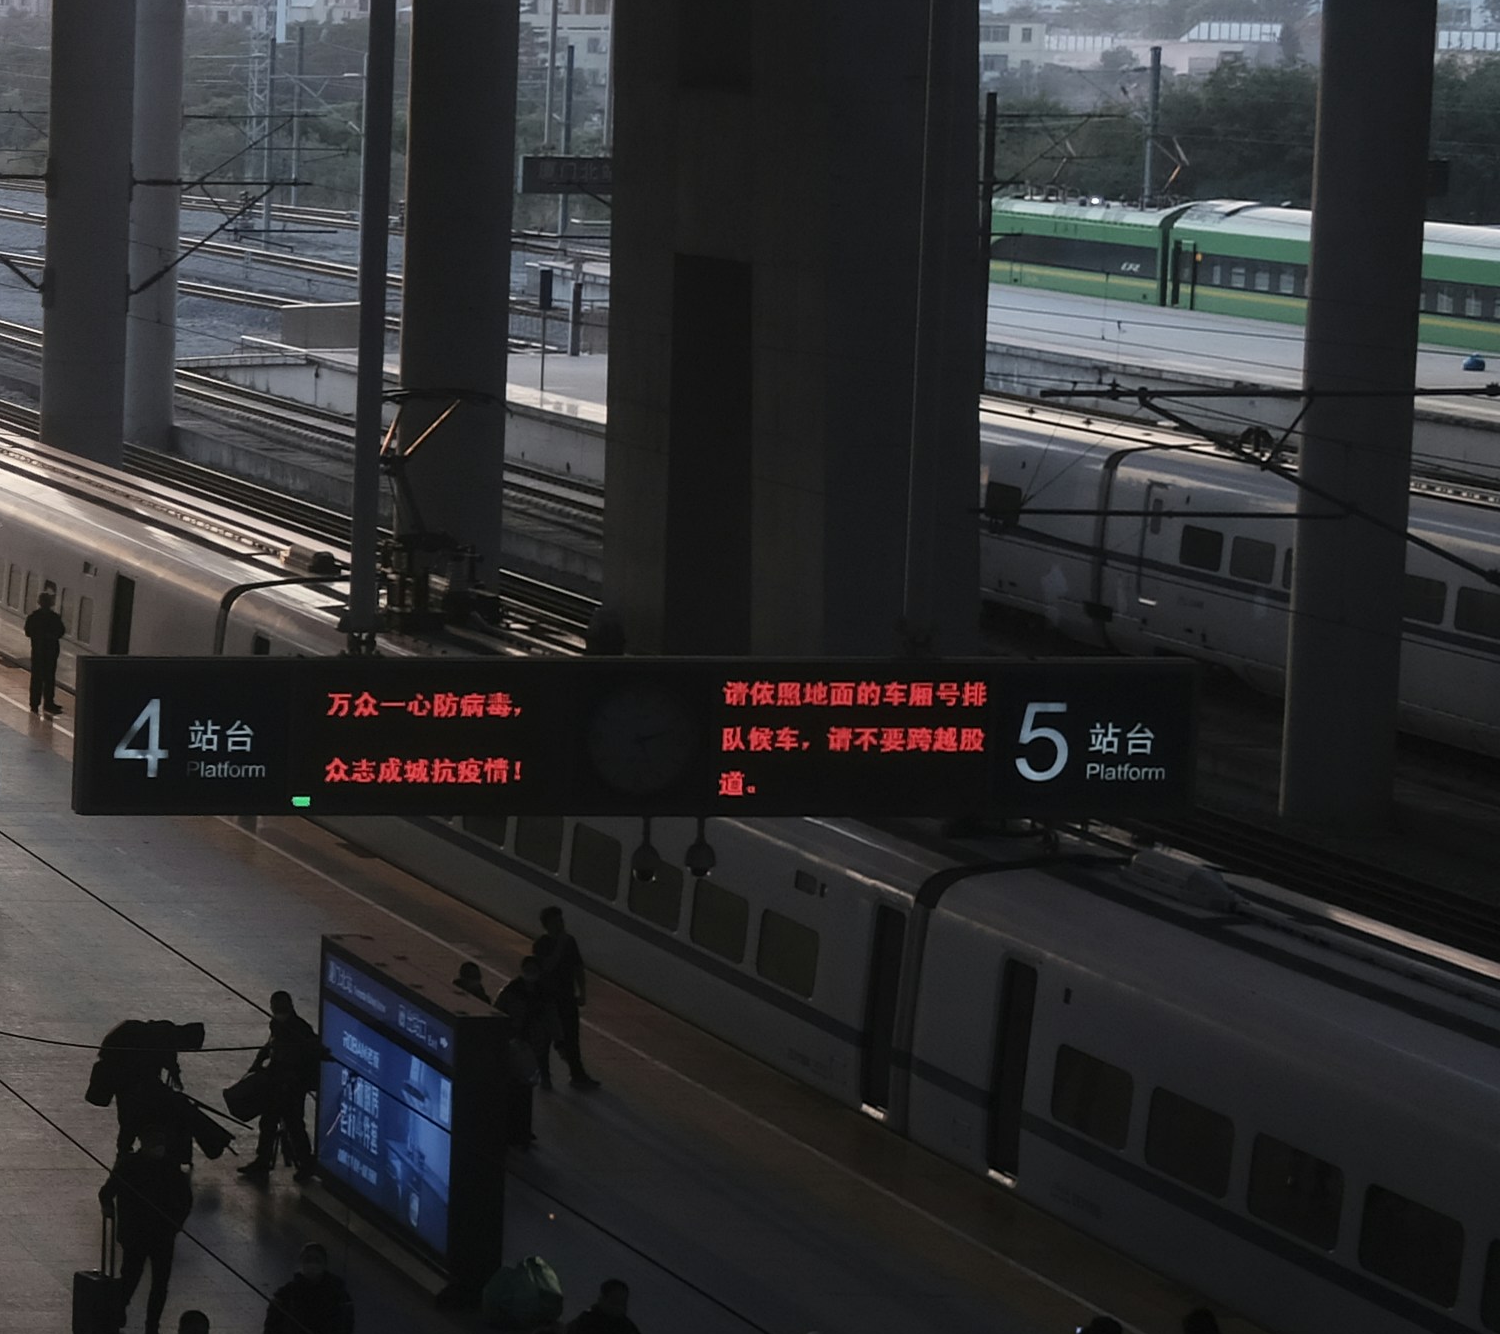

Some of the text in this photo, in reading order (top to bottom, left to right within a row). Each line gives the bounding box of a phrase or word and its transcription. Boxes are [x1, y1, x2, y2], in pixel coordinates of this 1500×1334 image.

[326, 692, 522, 718] 万众一心防病毒，
[723, 681, 987, 706] 请依照地面的车厢号排
[113, 698, 255, 778] 4 站台
[1015, 702, 1155, 782] 5 站台
[187, 761, 265, 779] Platform
[324, 757, 522, 784] 众志成城抗疫情！
[719, 770, 756, 796] 道。
[1086, 763, 1165, 781] Platform
